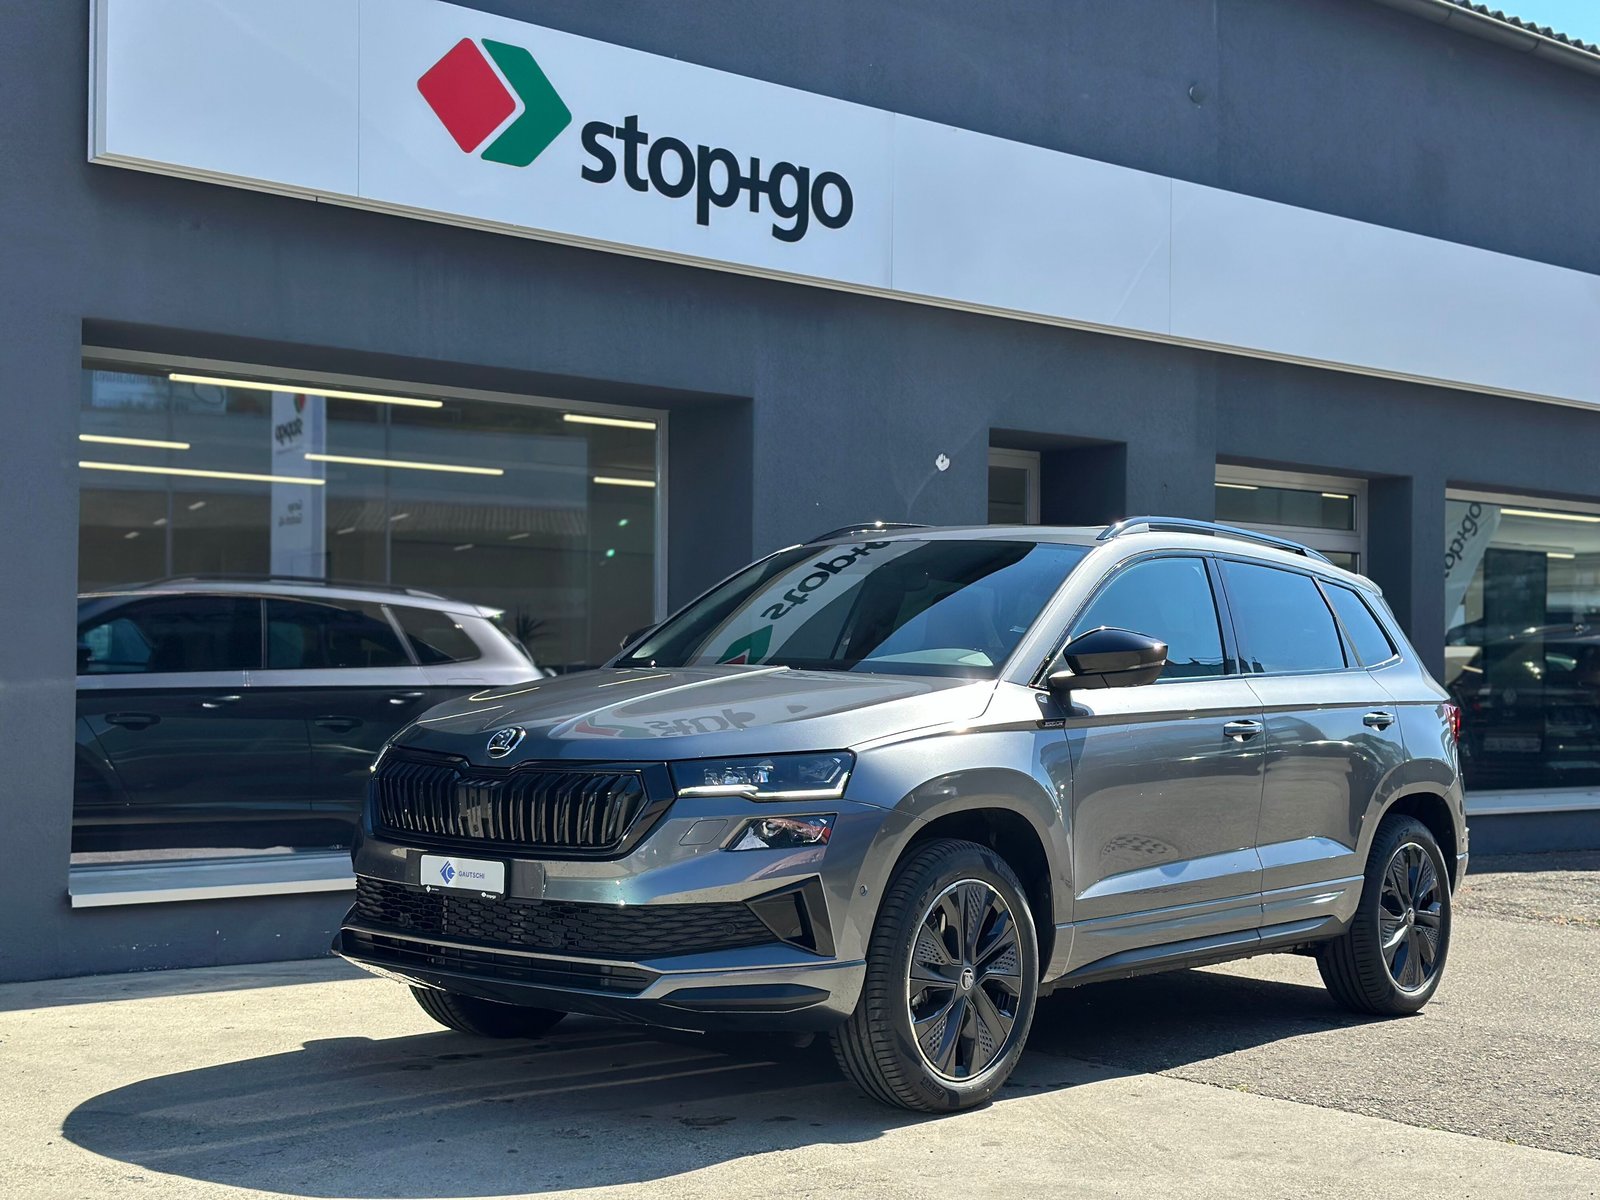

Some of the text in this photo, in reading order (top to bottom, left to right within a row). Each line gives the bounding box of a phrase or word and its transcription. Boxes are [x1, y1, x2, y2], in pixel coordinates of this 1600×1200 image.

[581, 114, 854, 243] stop+go
[1445, 502, 1482, 579] op+go
[458, 871, 485, 880] GAUTSCHI
